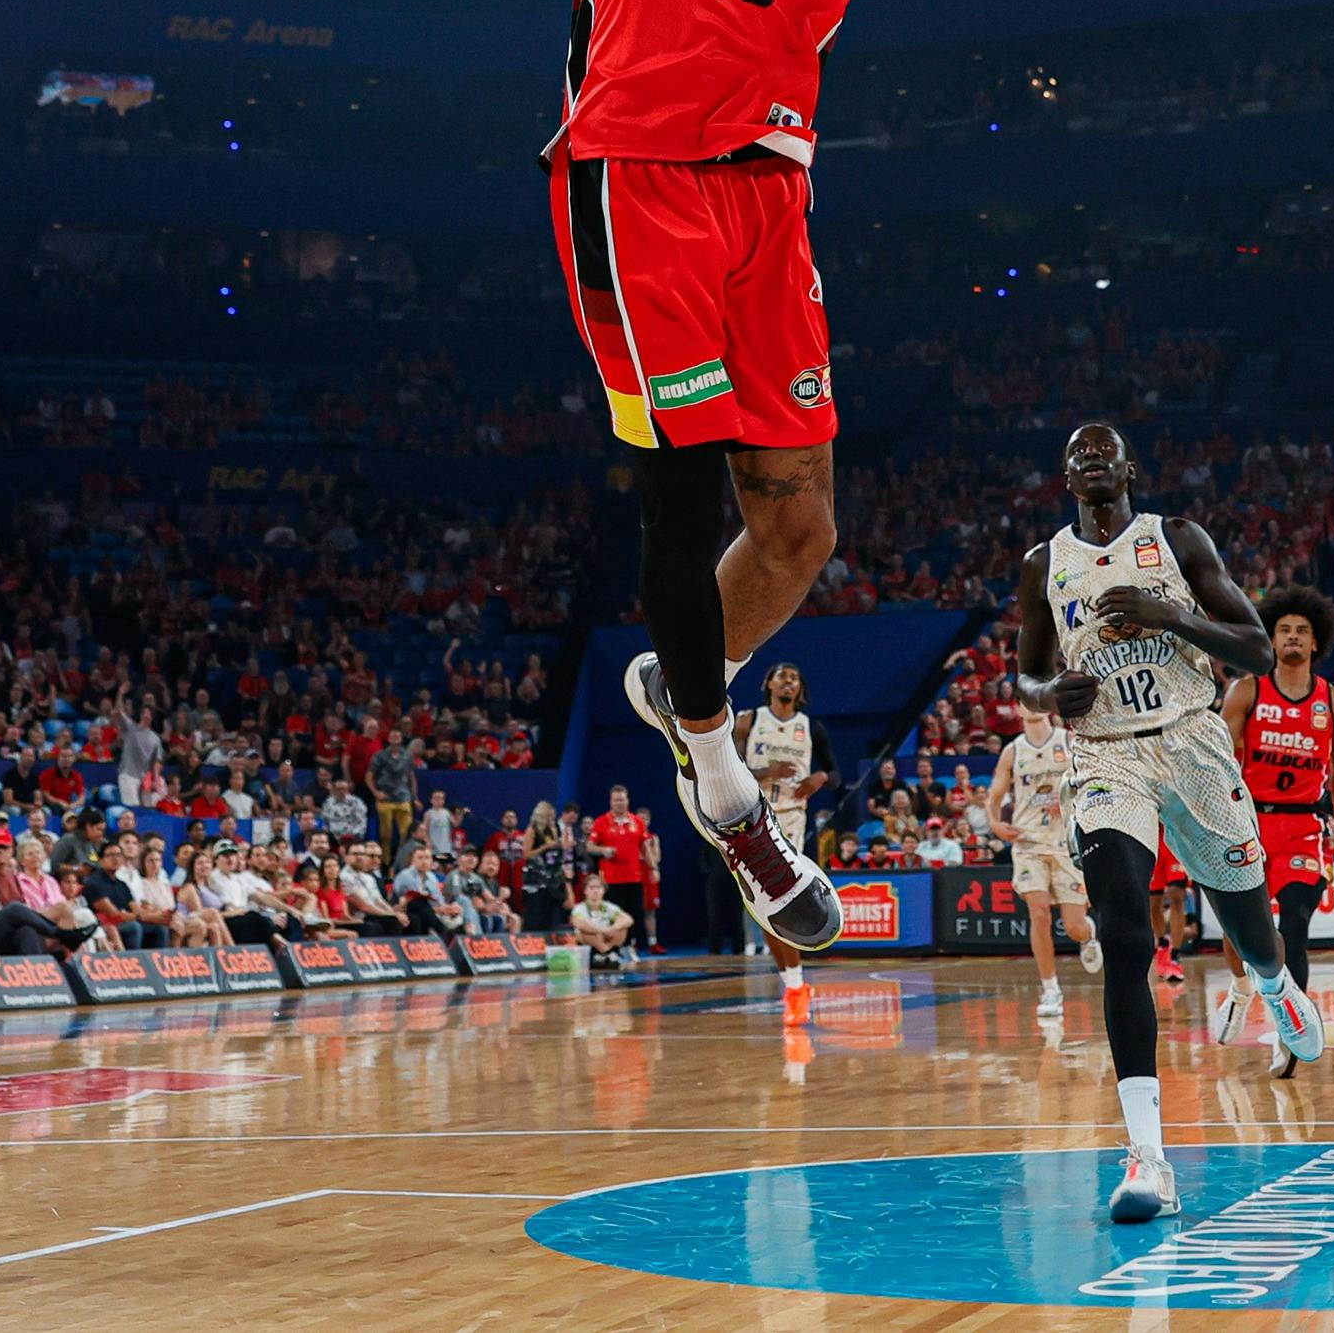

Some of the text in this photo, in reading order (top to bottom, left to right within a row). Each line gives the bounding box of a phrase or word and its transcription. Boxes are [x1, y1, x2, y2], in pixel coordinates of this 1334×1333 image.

[166, 13, 235, 42] RAC
[657, 367, 728, 400] HOLMAN
[798, 380, 817, 397] NBL
[1079, 629, 1176, 683] TAIPANS
[1115, 668, 1163, 714] 42
[1276, 770, 1296, 792] 0
[956, 880, 1016, 913] RE
[843, 903, 892, 921] EMIST
[293, 941, 345, 968] Coates
[399, 937, 450, 963] Coates
[464, 935, 508, 959] Coates
[81, 953, 147, 982] Coates
[151, 951, 212, 978] Coates
[216, 947, 275, 975] Coates
